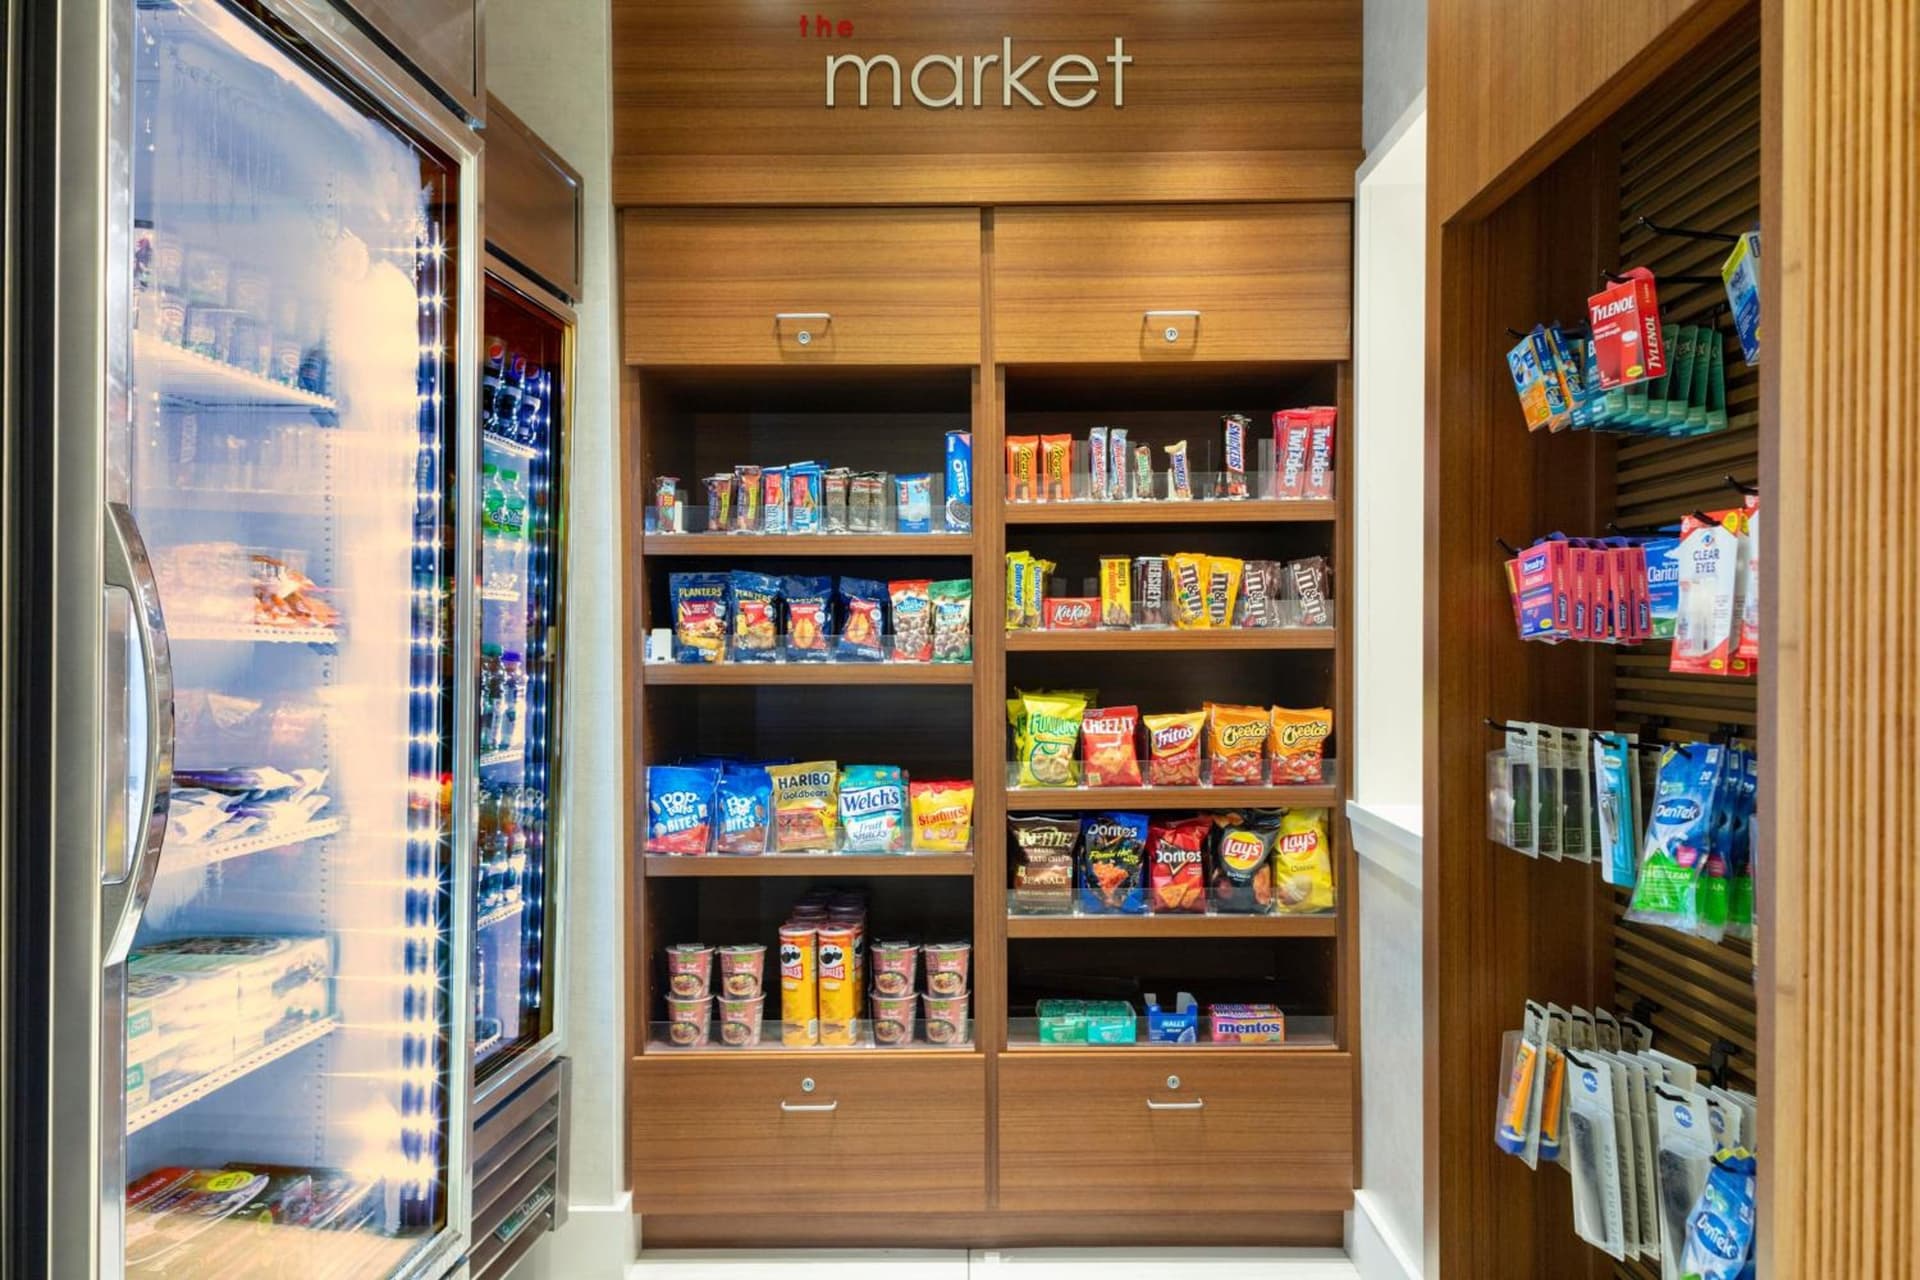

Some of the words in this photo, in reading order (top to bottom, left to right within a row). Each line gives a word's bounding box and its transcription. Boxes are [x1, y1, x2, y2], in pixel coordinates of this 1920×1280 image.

[800, 15, 854, 38] the
[825, 36, 1133, 108] market
[1591, 296, 1635, 325] TYLENOL
[1645, 316, 1662, 370] TYLENOL
[1228, 422, 1242, 470] SNICKERS
[952, 459, 967, 498] OREO
[1693, 549, 1720, 561] CLEAR
[1695, 561, 1716, 574] EYES
[679, 587, 722, 597] PLANTERS
[1147, 559, 1163, 609] HERSHEY'S
[1156, 725, 1194, 747] Fritos
[1223, 721, 1270, 746] Cheetos
[1282, 721, 1328, 746] Cheetos
[778, 772, 831, 790] HARIBO
[782, 789, 828, 801] Goldbears
[843, 788, 900, 813] Welch's
[1655, 803, 1699, 820] DenTek
[666, 814, 699, 833] BITES
[726, 815, 756, 832] BITES
[1087, 823, 1138, 838] Doritos
[1162, 1020, 1186, 1028] HALLS
[1218, 1022, 1281, 1034] mentos
[1697, 1216, 1736, 1257] DenTek
